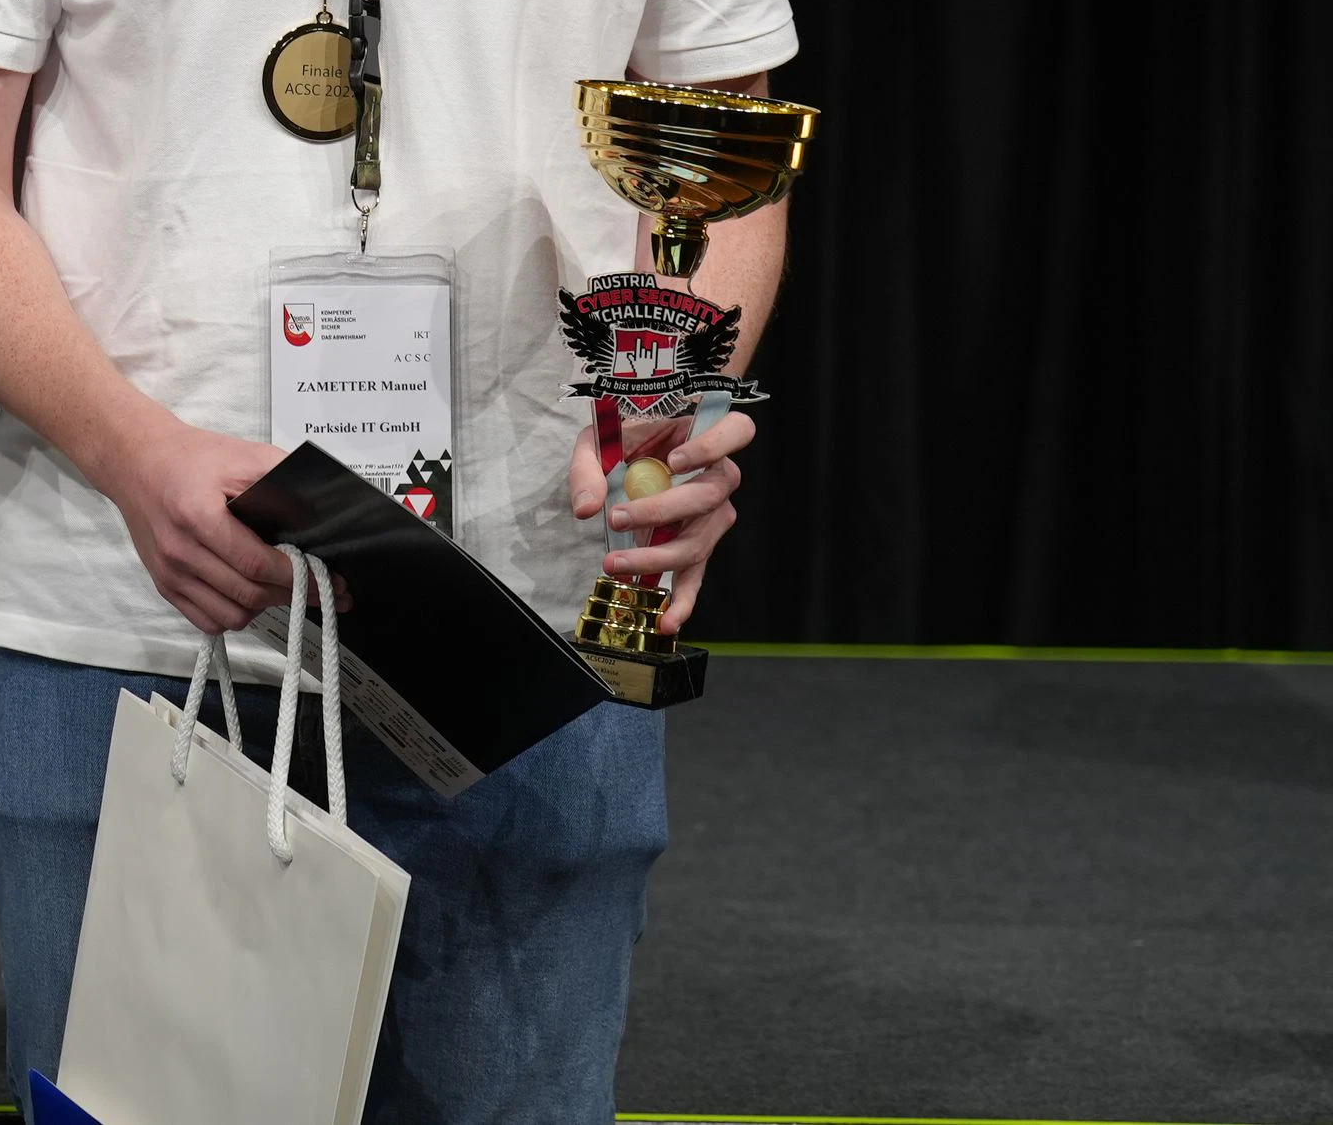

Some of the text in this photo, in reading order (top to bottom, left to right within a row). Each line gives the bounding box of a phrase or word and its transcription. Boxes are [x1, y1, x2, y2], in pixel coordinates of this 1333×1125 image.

[302, 64, 343, 79] Finale
[284, 83, 321, 97] ACSC
[593, 274, 656, 292] AUSTRIA
[576, 288, 726, 325] CYBER SECURITY
[602, 304, 696, 332] CHALLENGE
[413, 331, 431, 339] IKT
[297, 380, 427, 393] ZAMETTER Manuel
[600, 374, 685, 392] Du bist verboten gut?
[693, 380, 707, 388] Dann
[305, 421, 421, 434] Parkside IT GmbH
[585, 654, 616, 666] ACSC2022
